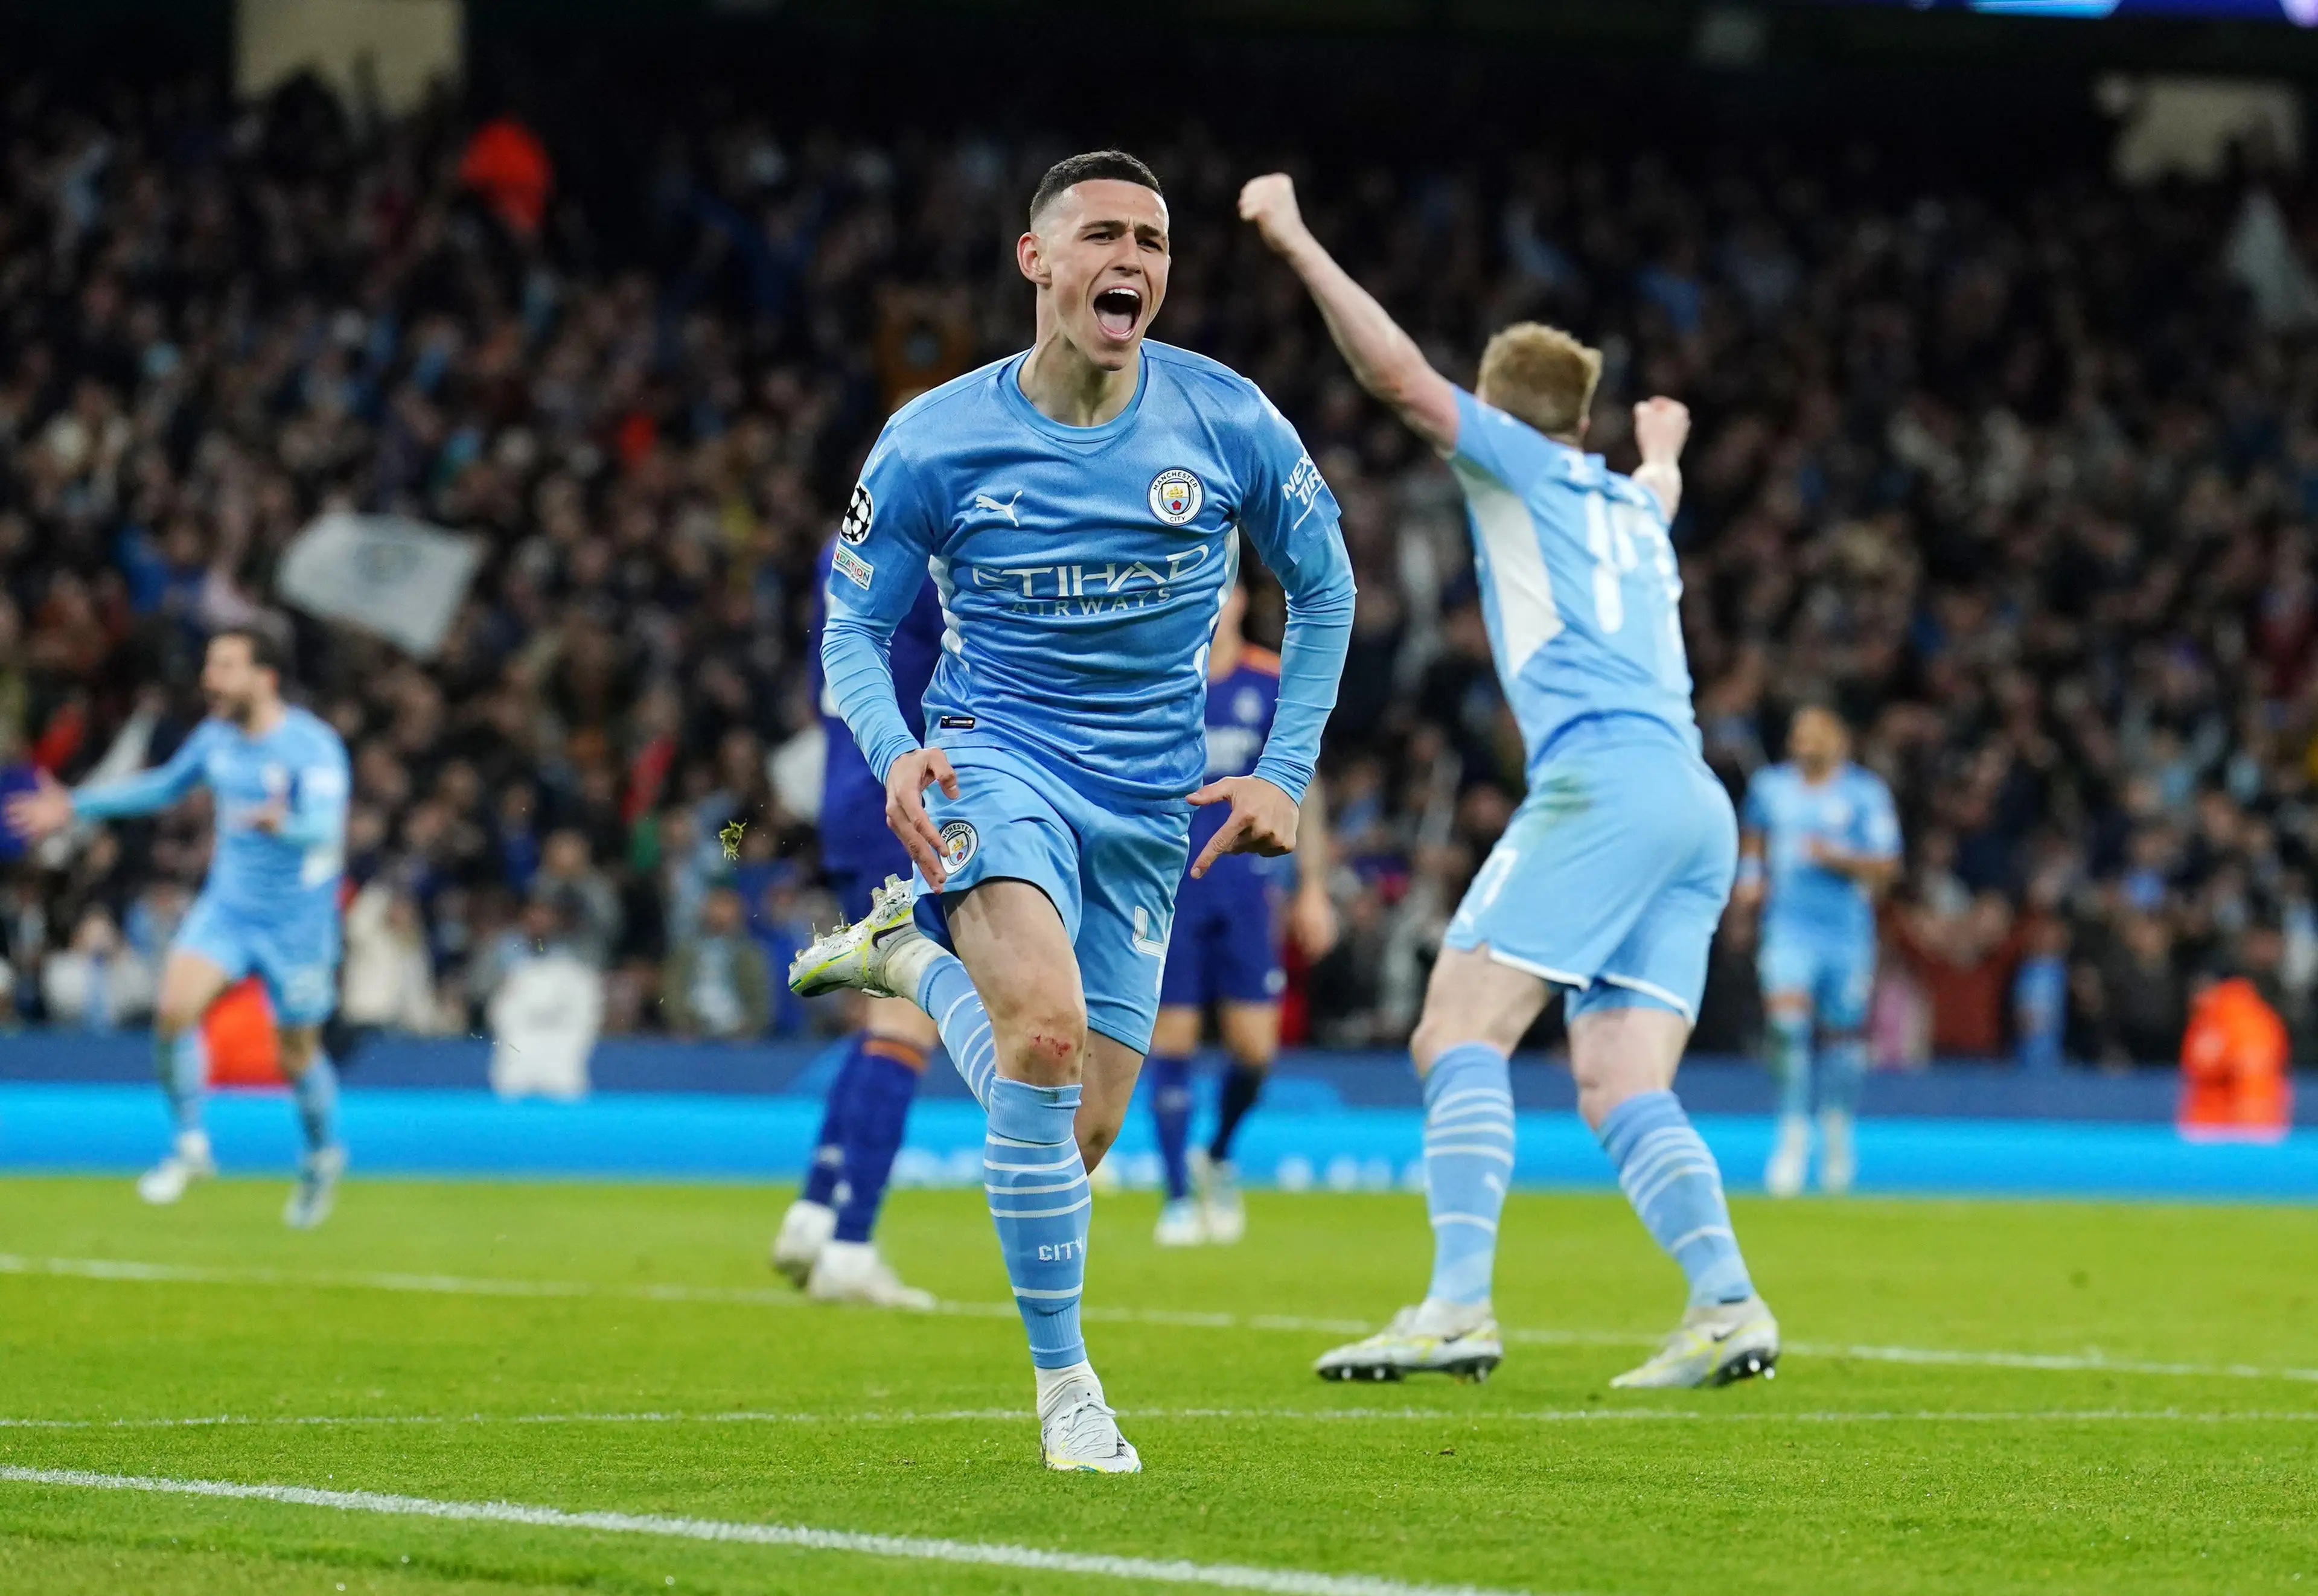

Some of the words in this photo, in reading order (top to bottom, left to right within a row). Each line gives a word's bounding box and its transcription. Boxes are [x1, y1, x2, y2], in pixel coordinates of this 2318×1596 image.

[1153, 471, 1198, 491] MANCHESTER
[1282, 448, 1313, 500] NEX
[1295, 466, 1323, 505] TIR
[972, 544, 1209, 596] ETIHAD
[1011, 587, 1171, 616] AIRWAYS
[942, 824, 972, 840] NCHESTER
[1038, 1236, 1083, 1262] CITY
